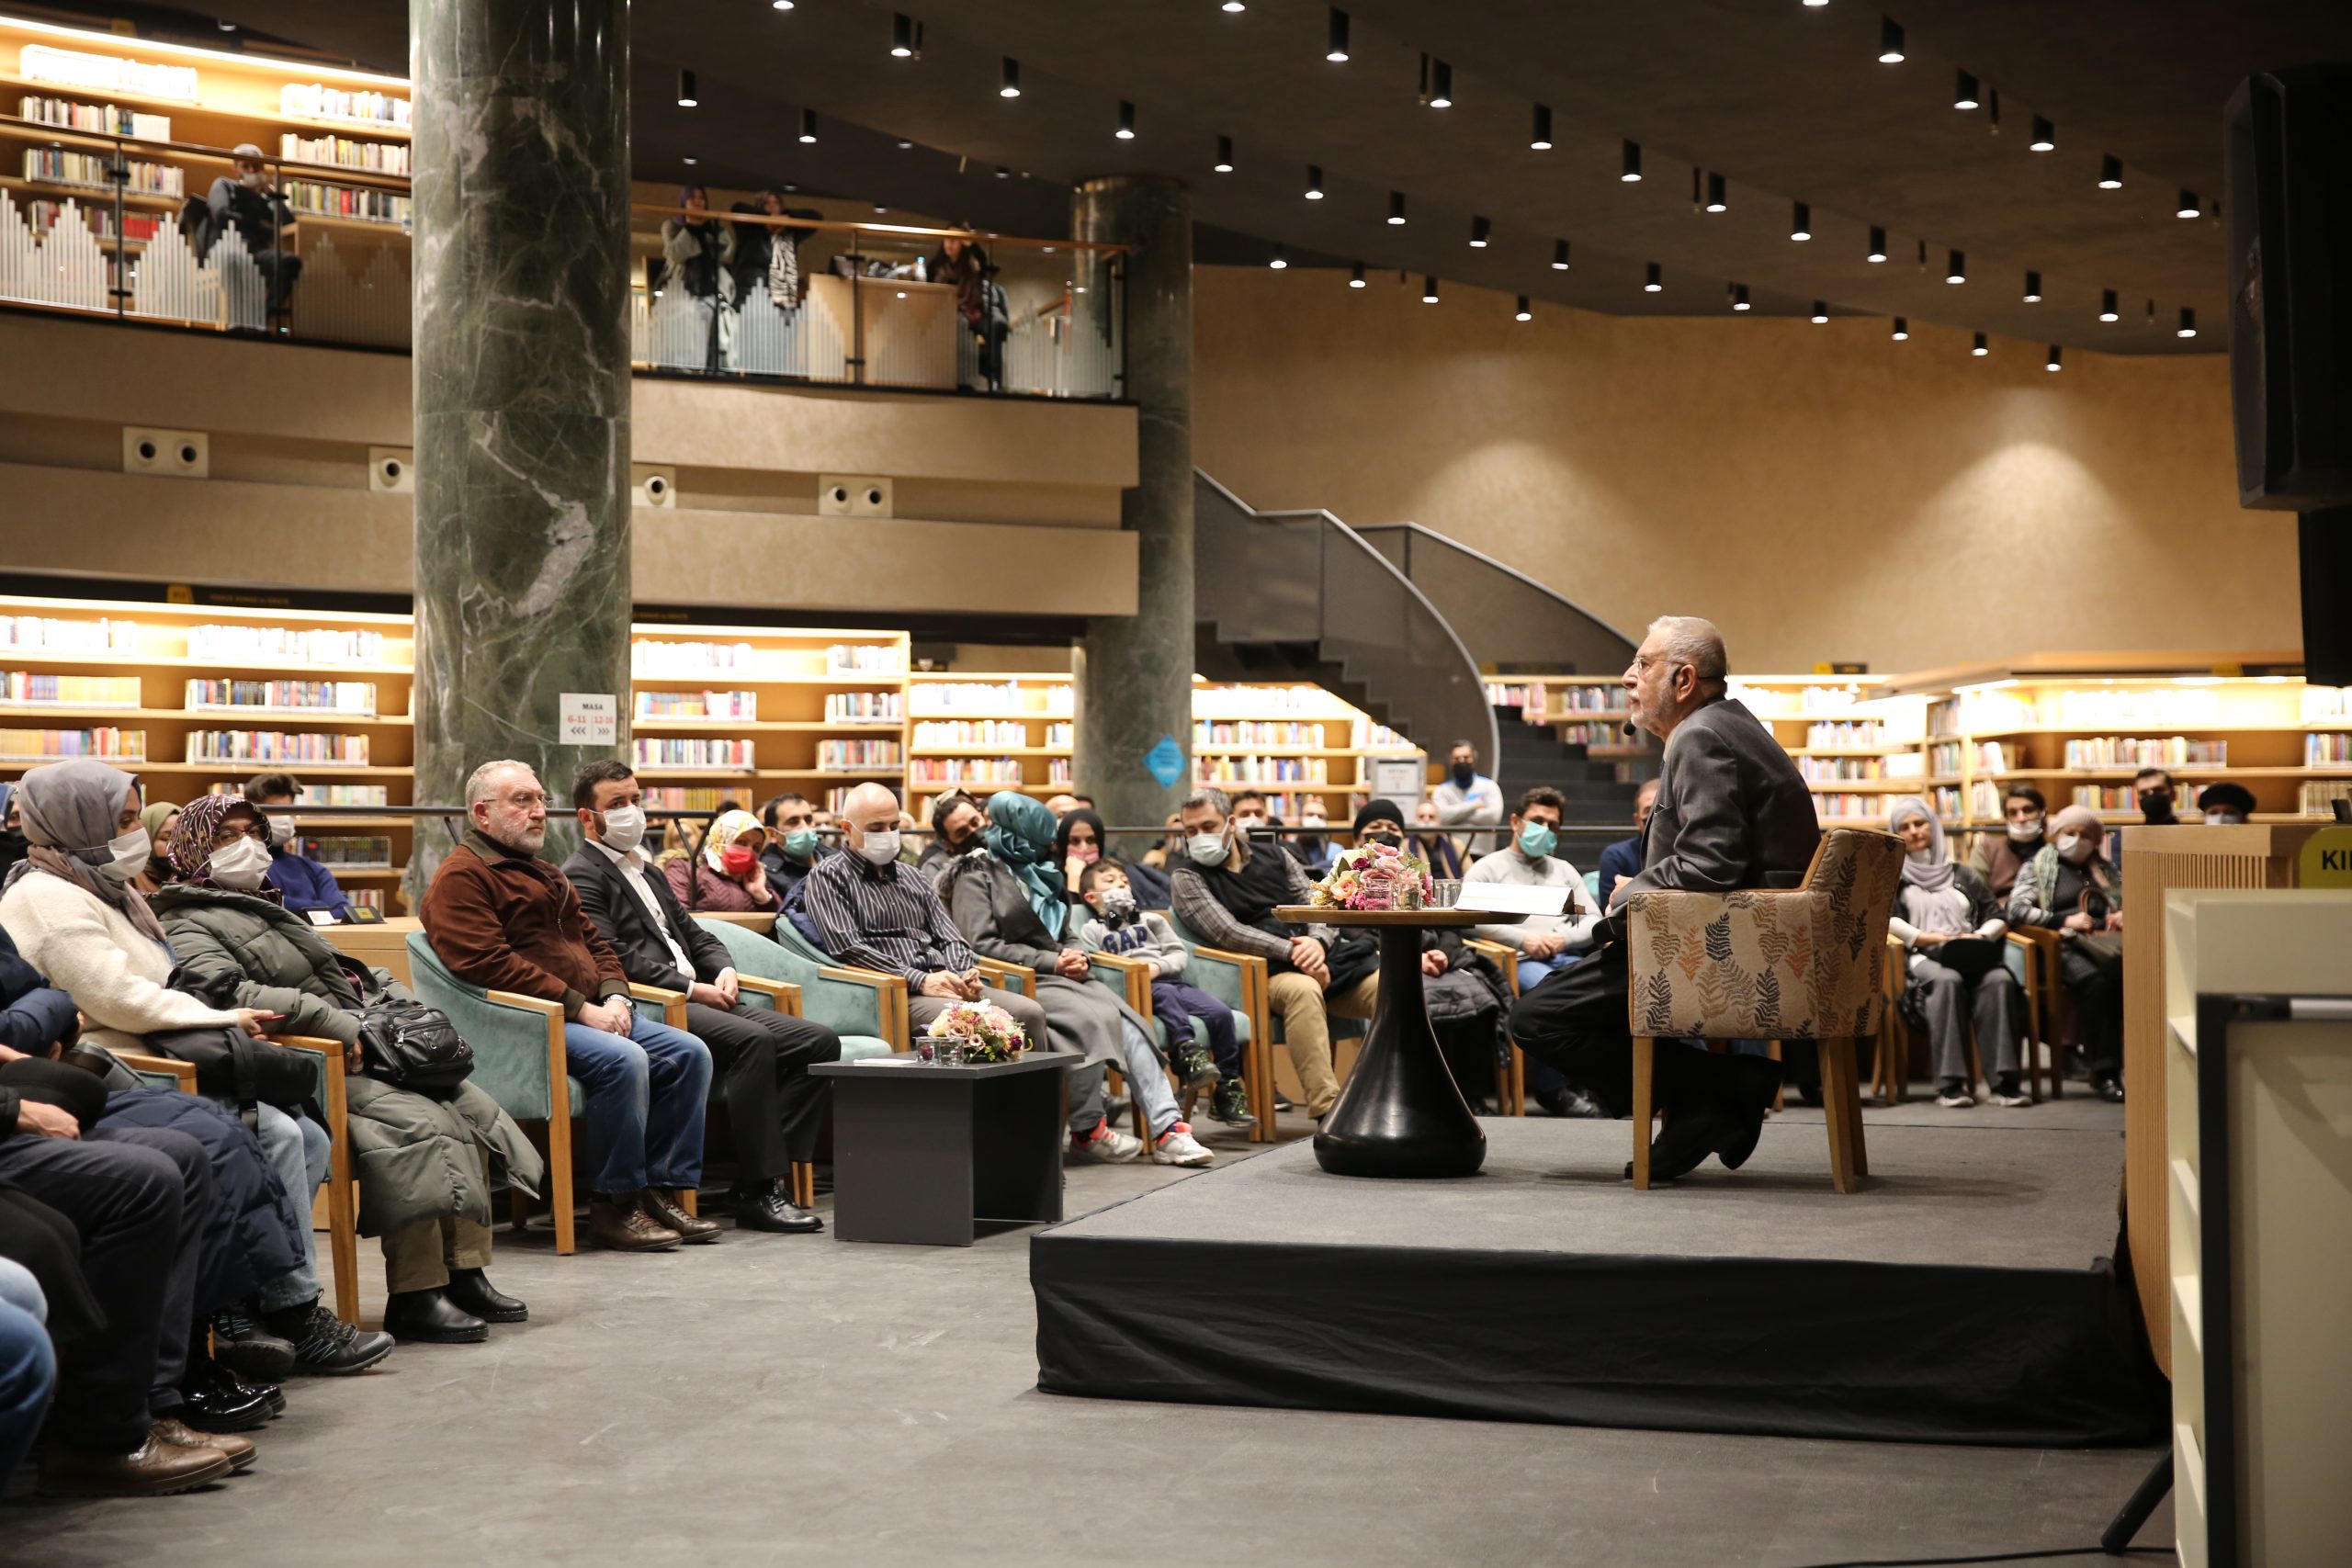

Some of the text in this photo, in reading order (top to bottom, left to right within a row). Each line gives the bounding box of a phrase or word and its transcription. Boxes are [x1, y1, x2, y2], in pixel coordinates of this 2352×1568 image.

[582, 703, 604, 711] MASA
[2322, 849, 2352, 872] KI
[1102, 926, 1148, 954] GAP
